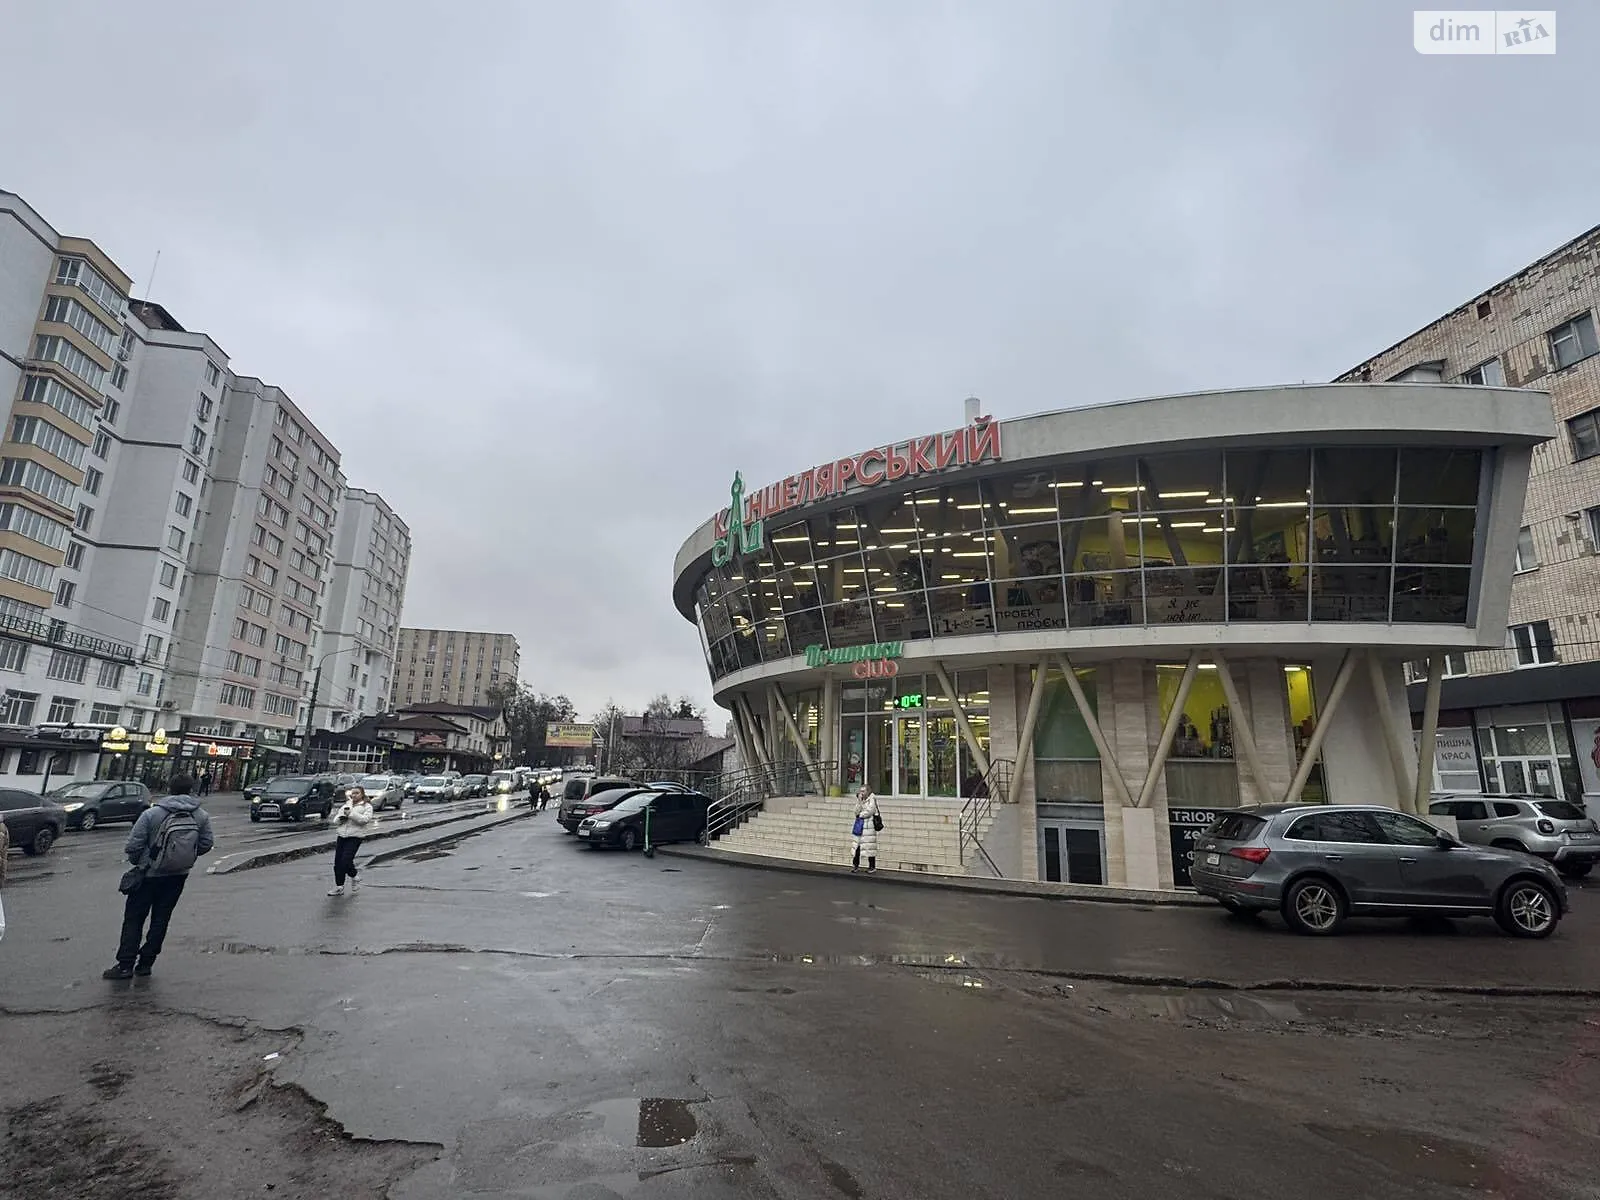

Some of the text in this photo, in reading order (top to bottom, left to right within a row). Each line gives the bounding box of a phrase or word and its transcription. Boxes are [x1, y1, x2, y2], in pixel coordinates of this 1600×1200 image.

[851, 656, 899, 679] club
[1436, 738, 1473, 748] ПИШНА
[1441, 751, 1472, 760] КРАСА
